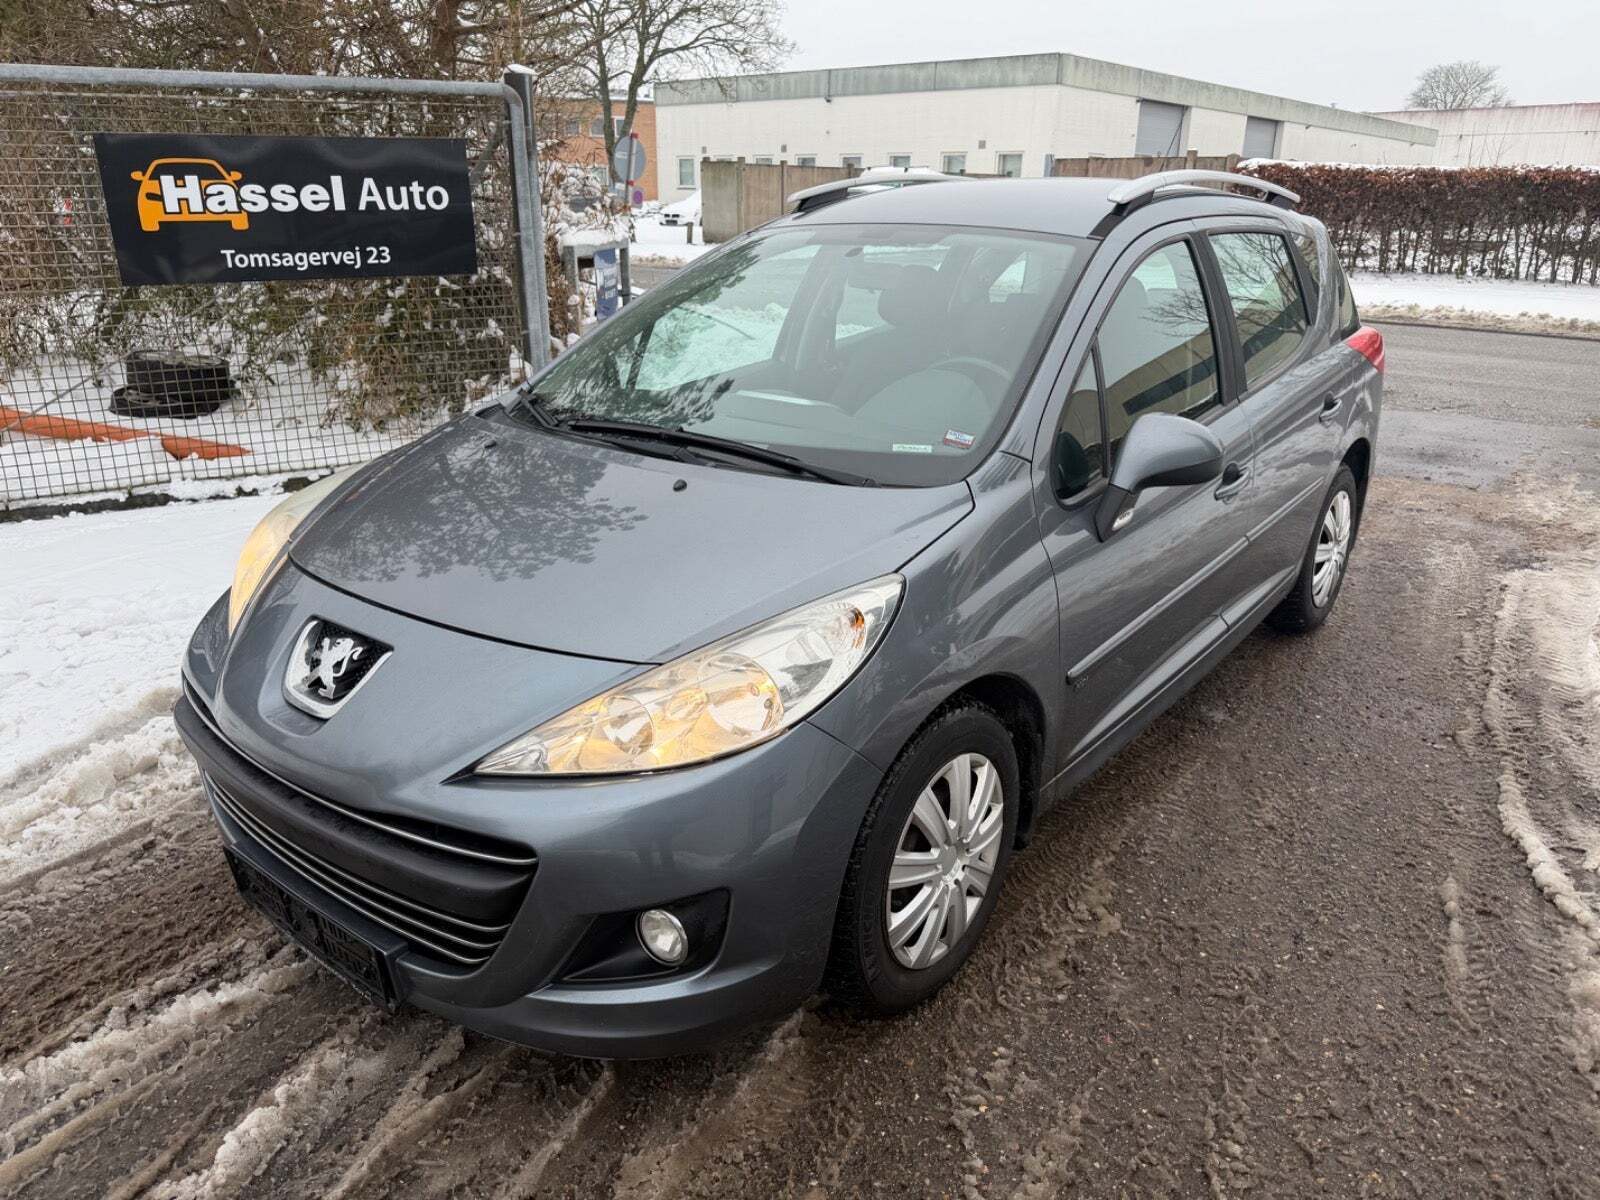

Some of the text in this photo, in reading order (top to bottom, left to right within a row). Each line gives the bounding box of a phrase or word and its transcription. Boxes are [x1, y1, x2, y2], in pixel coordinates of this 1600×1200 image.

[160, 174, 449, 212] Hassel Auto
[221, 247, 390, 270] Tomsagervej 23
